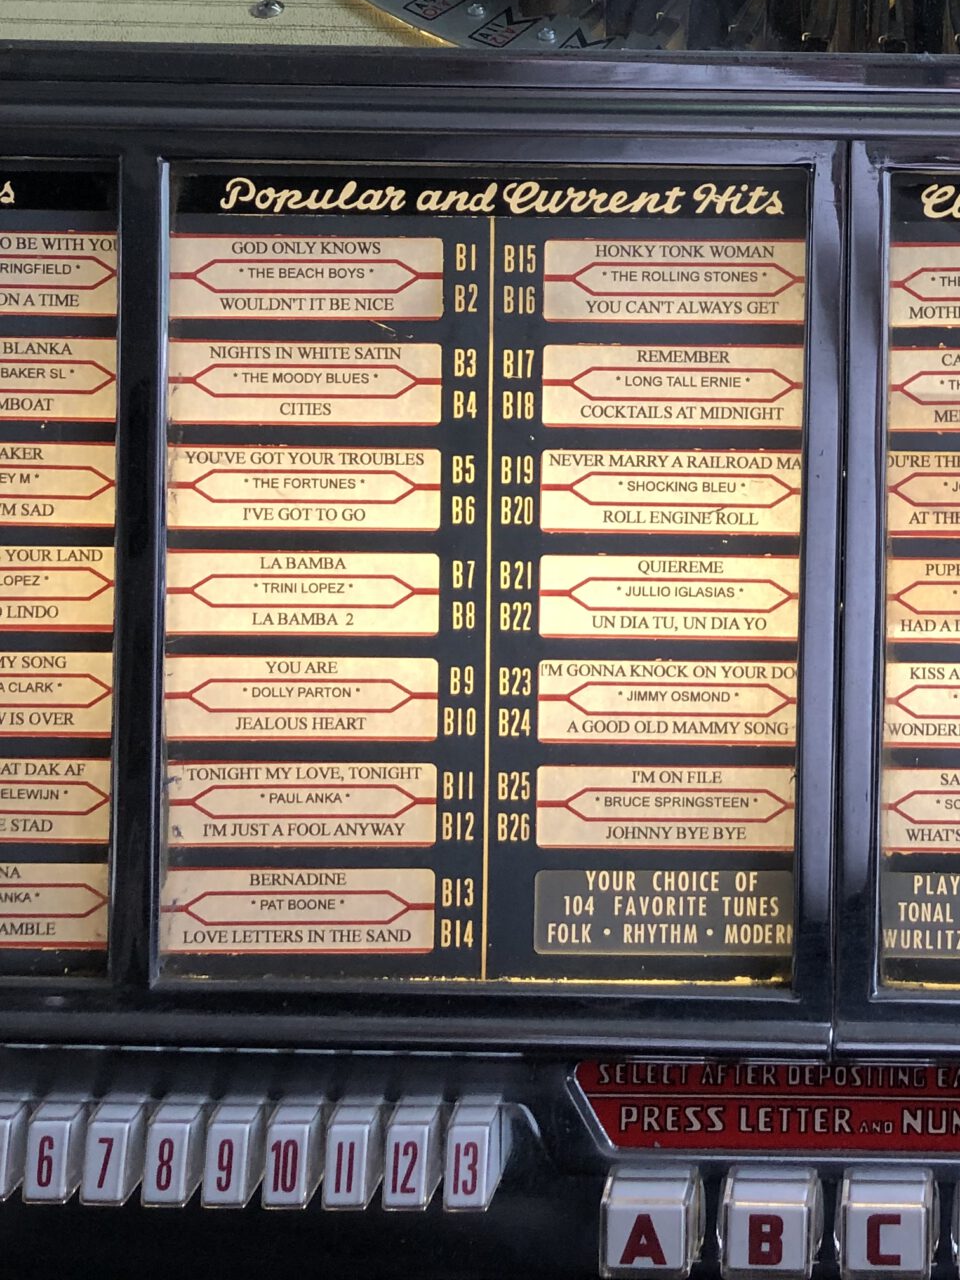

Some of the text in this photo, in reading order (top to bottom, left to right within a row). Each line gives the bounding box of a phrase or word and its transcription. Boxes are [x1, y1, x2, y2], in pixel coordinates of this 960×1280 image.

[220, 177, 785, 215] Popular and Current Hits
[231, 241, 381, 255] GOD ONLY KNOWS
[595, 244, 775, 259] HONKY TONK WOMAN
[455, 243, 476, 271] B1
[247, 267, 365, 280] THE BEACH BOYS
[2, 341, 73, 356] BLANKA
[209, 345, 402, 360] NIGHTS IN WHITE SATIN
[637, 349, 731, 364] REMEMBER
[0, 367, 67, 380] BAKER SL
[241, 372, 370, 385] THE MOODY BLUES
[279, 402, 332, 416] CITIES
[261, 582, 345, 594] TRINI LOPEZ
[6, 605, 59, 619] LINDO
[251, 686, 352, 698] DOLLY PARTON
[626, 690, 729, 703] JIMMY OSMOND
[9, 711, 75, 726] IS OVER
[235, 716, 367, 731] JEALOUS HEART
[443, 771, 474, 800] B11
[604, 796, 750, 809] BRUCE SPRINGSTEEN
[249, 872, 347, 887] BERNADINE
[585, 870, 758, 892] YOUR CHOICE OF
[259, 898, 336, 911] PAT BOONE
[563, 895, 779, 917] 104 FAVORITE TUNES
[897, 901, 954, 923] TONAL
[547, 923, 592, 944] FOLK
[623, 923, 698, 944] RHYTHM
[600, 1063, 687, 1084] SELECT
[702, 1064, 776, 1086] AFTER
[788, 1065, 926, 1088] DEPOSITING
[620, 1106, 724, 1131] PRESS
[740, 1107, 851, 1133] LETTER
[859, 1121, 893, 1134] AND
[36, 1135, 54, 1188] 6
[155, 1137, 175, 1192] 8
[271, 1139, 299, 1193] 10
[391, 1140, 419, 1194] 12
[452, 1141, 479, 1196] 13
[619, 1213, 668, 1266] A
[748, 1213, 784, 1266] B
[866, 1213, 902, 1267] C
